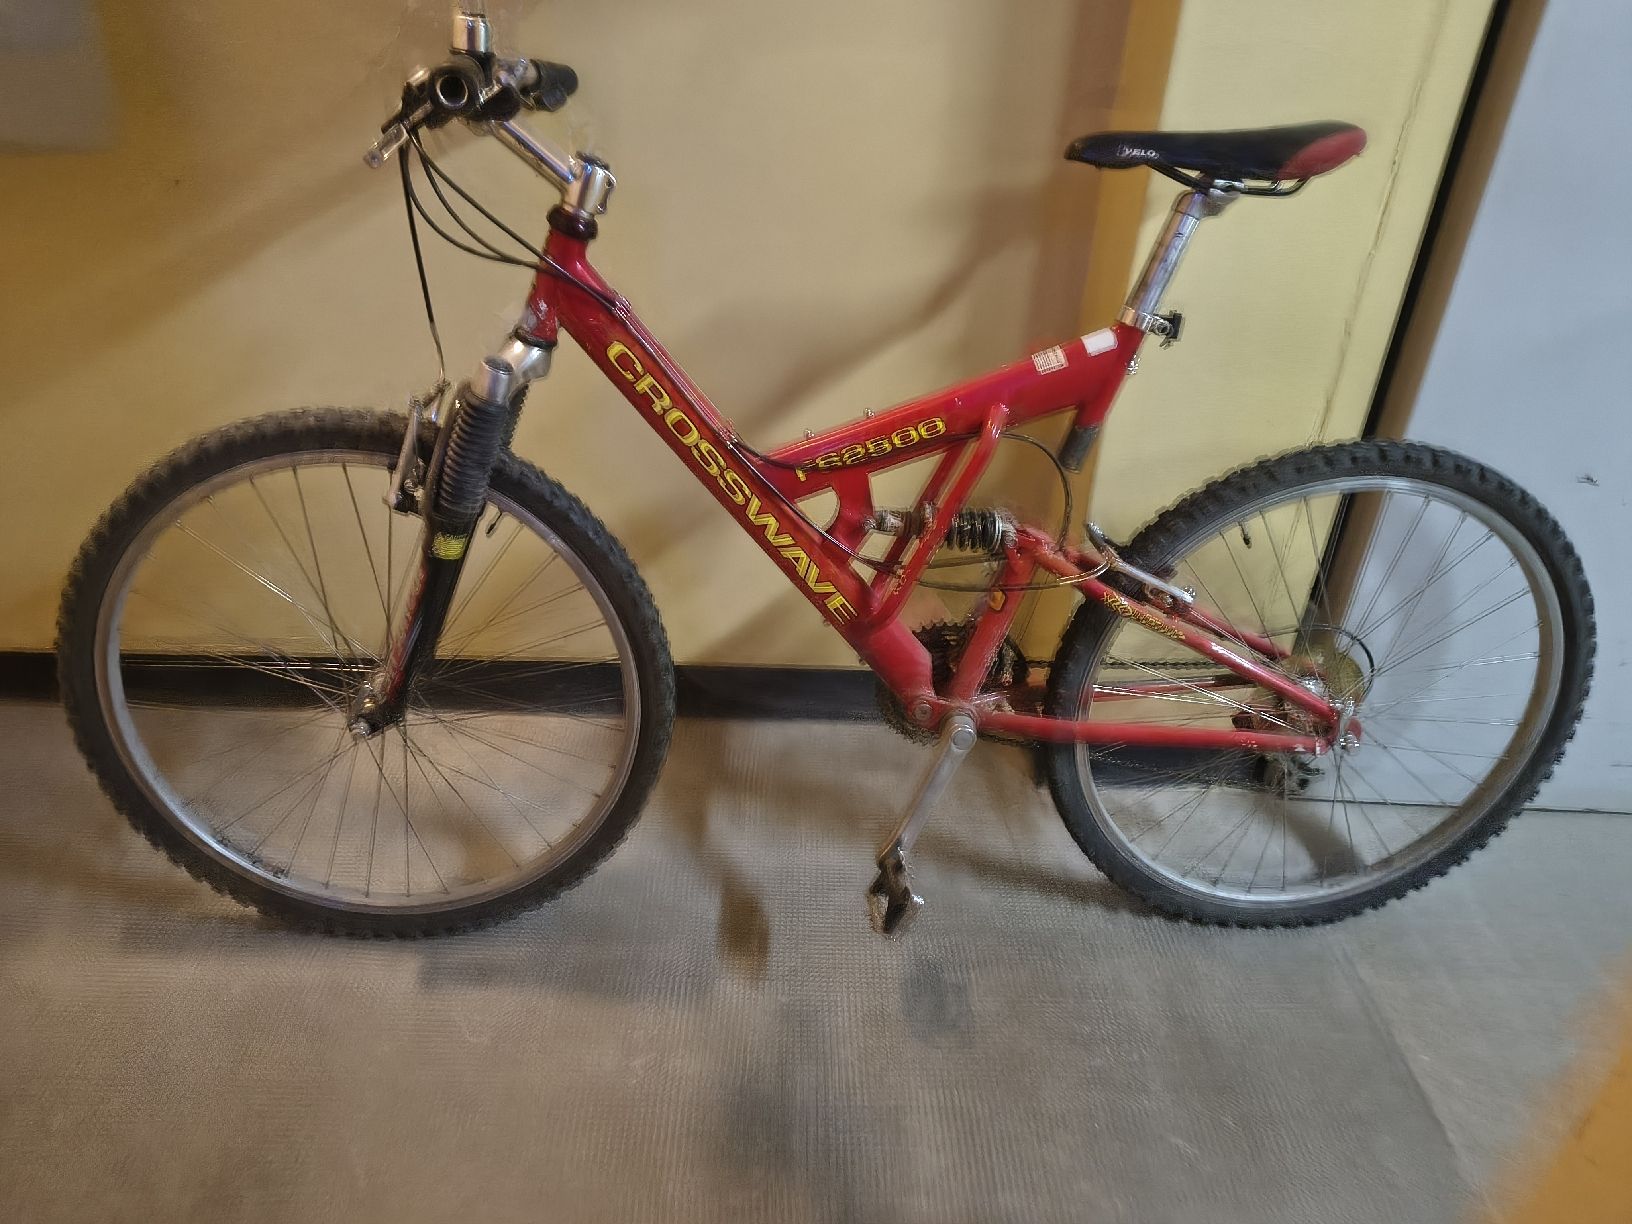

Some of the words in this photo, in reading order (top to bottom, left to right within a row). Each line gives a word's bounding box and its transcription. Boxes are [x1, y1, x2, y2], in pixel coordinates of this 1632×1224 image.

[1125, 148, 1157, 158] VELO
[795, 417, 946, 482] FS2500
[606, 341, 857, 624] CROSSWAVE
